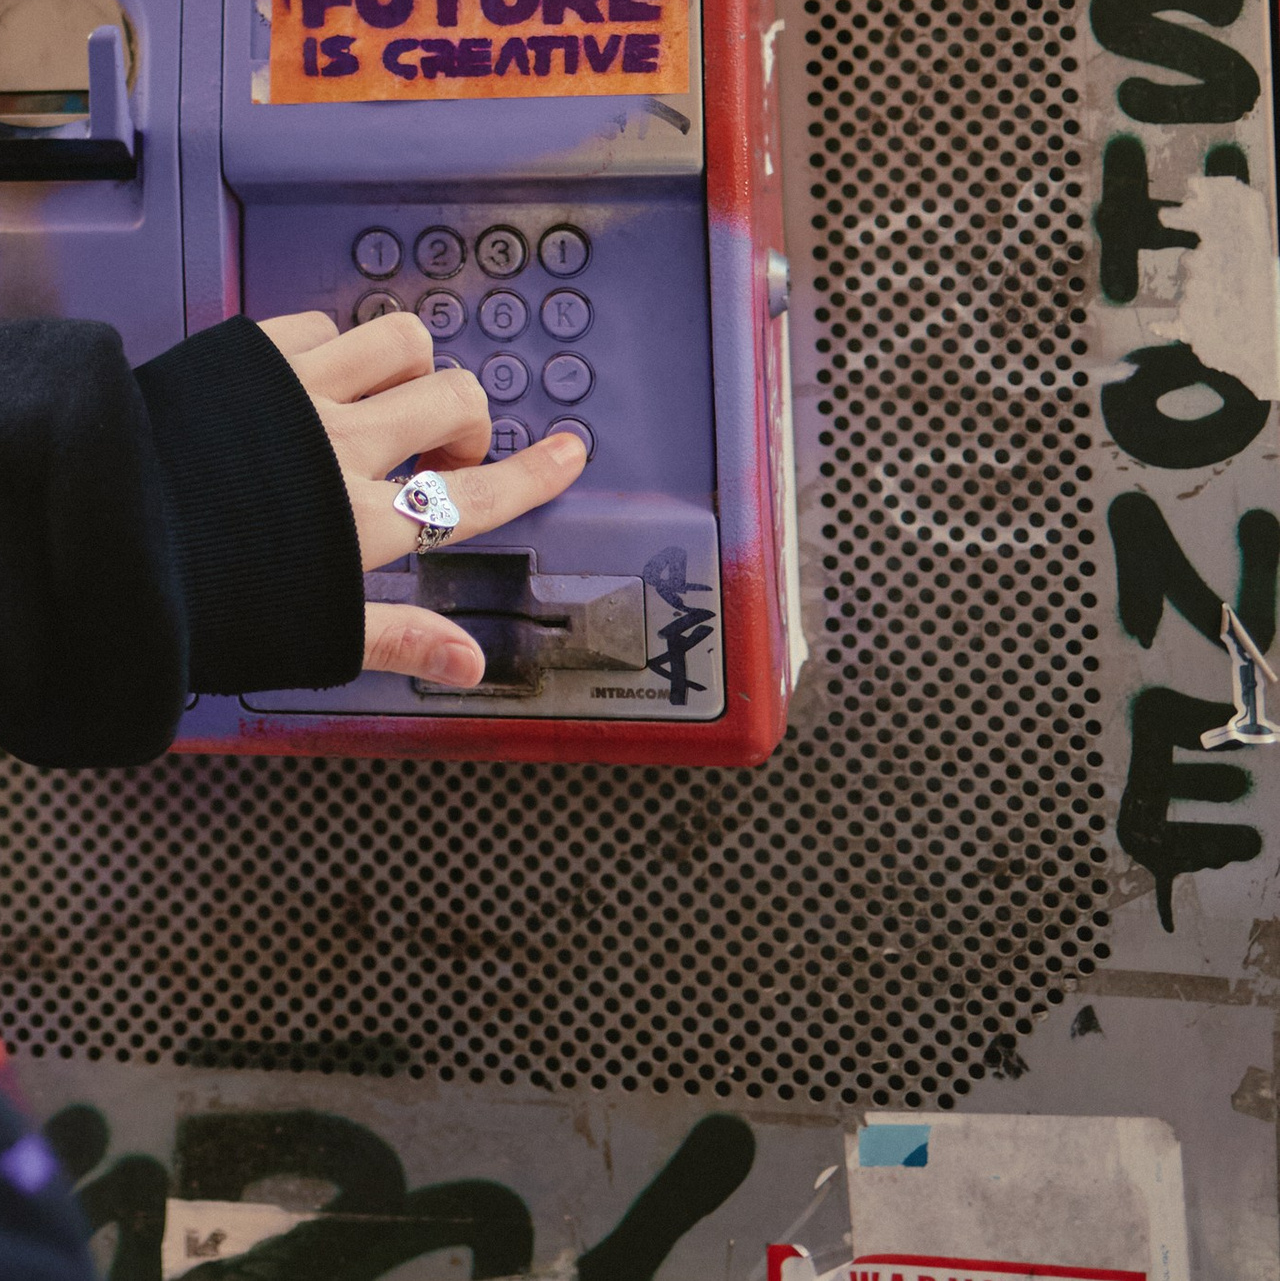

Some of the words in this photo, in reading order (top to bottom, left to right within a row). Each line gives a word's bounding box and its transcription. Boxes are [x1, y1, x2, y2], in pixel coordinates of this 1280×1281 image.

[303, 35, 361, 78] IS
[382, 33, 661, 80] CREATIVE
[429, 239, 449, 267] 2
[490, 239, 511, 267] 3
[431, 302, 451, 329] 5
[494, 302, 514, 329] 6
[555, 302, 575, 328] K
[493, 364, 514, 391] 9
[589, 686, 671, 700] INTRACOM
